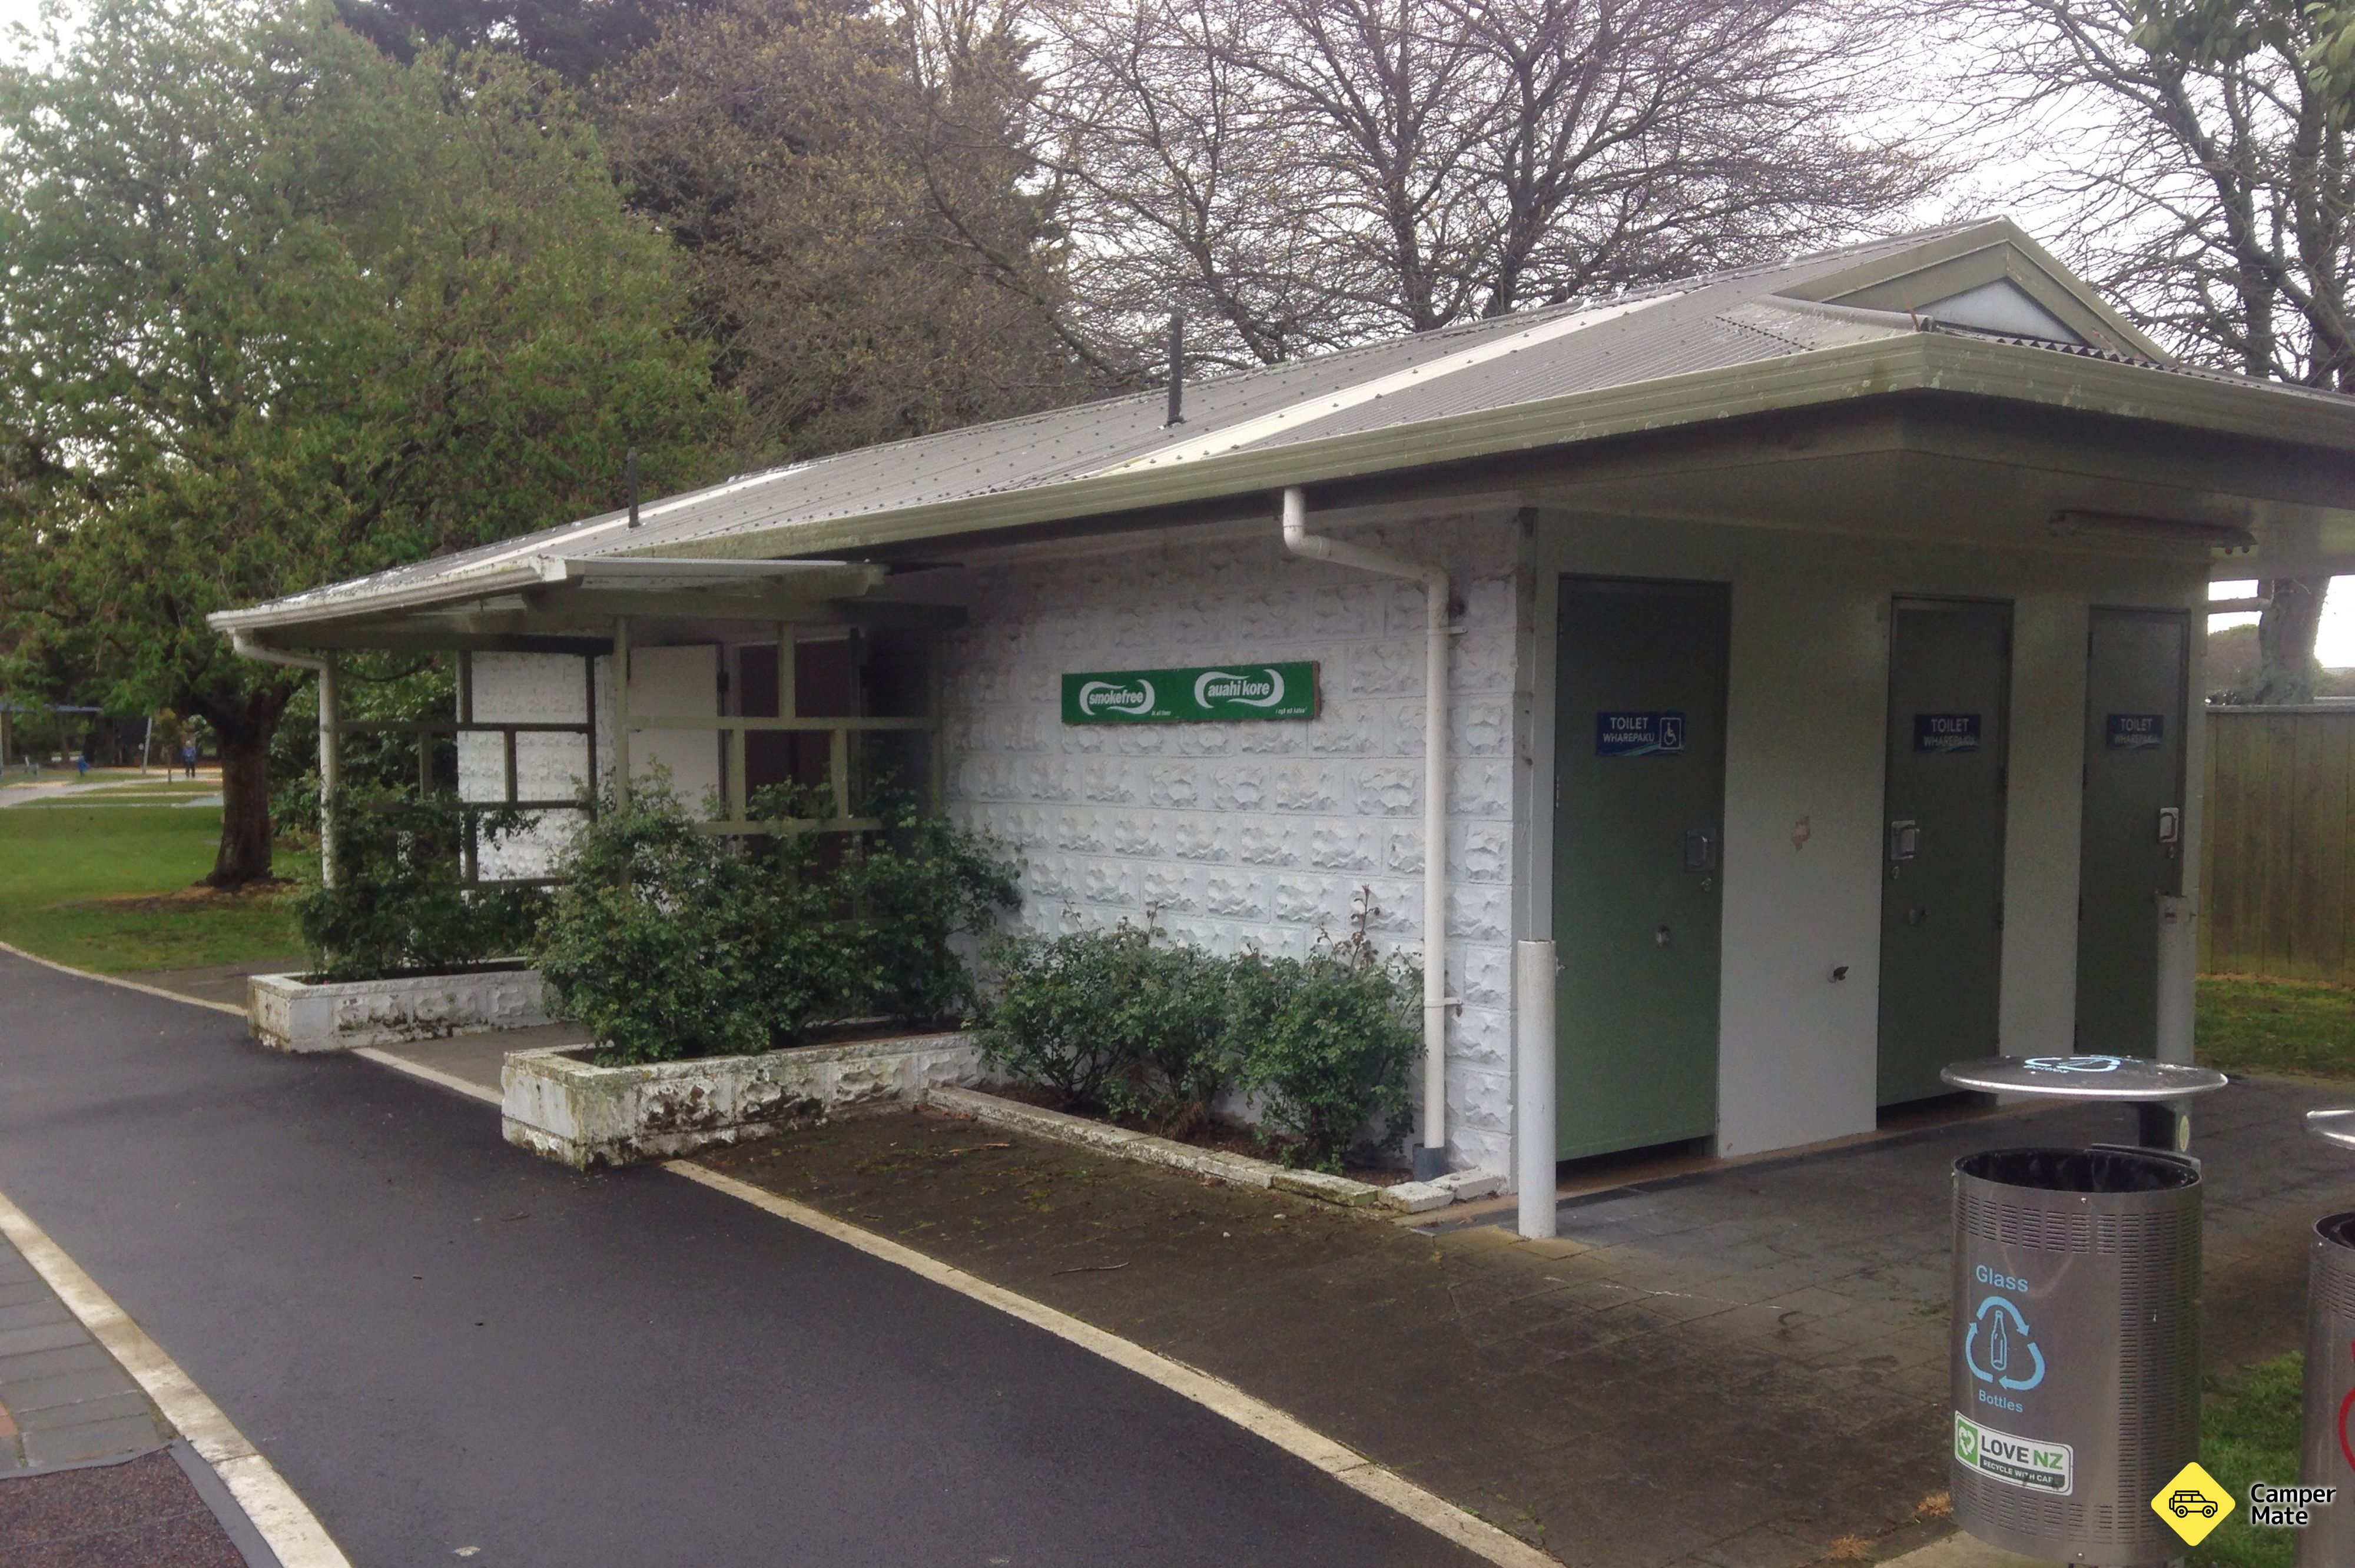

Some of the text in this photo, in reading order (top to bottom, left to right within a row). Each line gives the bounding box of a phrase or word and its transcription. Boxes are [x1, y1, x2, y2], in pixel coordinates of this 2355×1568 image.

[1208, 680, 1270, 697] auahi kore
[1089, 690, 1143, 705] smokefree
[1610, 717, 1648, 730] TOILET
[1931, 717, 1969, 733] TOILET
[2121, 717, 2153, 732] TOILET
[1603, 732, 1655, 743] WHAREPAKU
[1976, 1264, 2029, 1293] Glass
[1979, 1388, 2024, 1413] Bottles
[1982, 1435, 2064, 1470] LOVE NZ
[1983, 1460, 2013, 1475] RECYCLE
